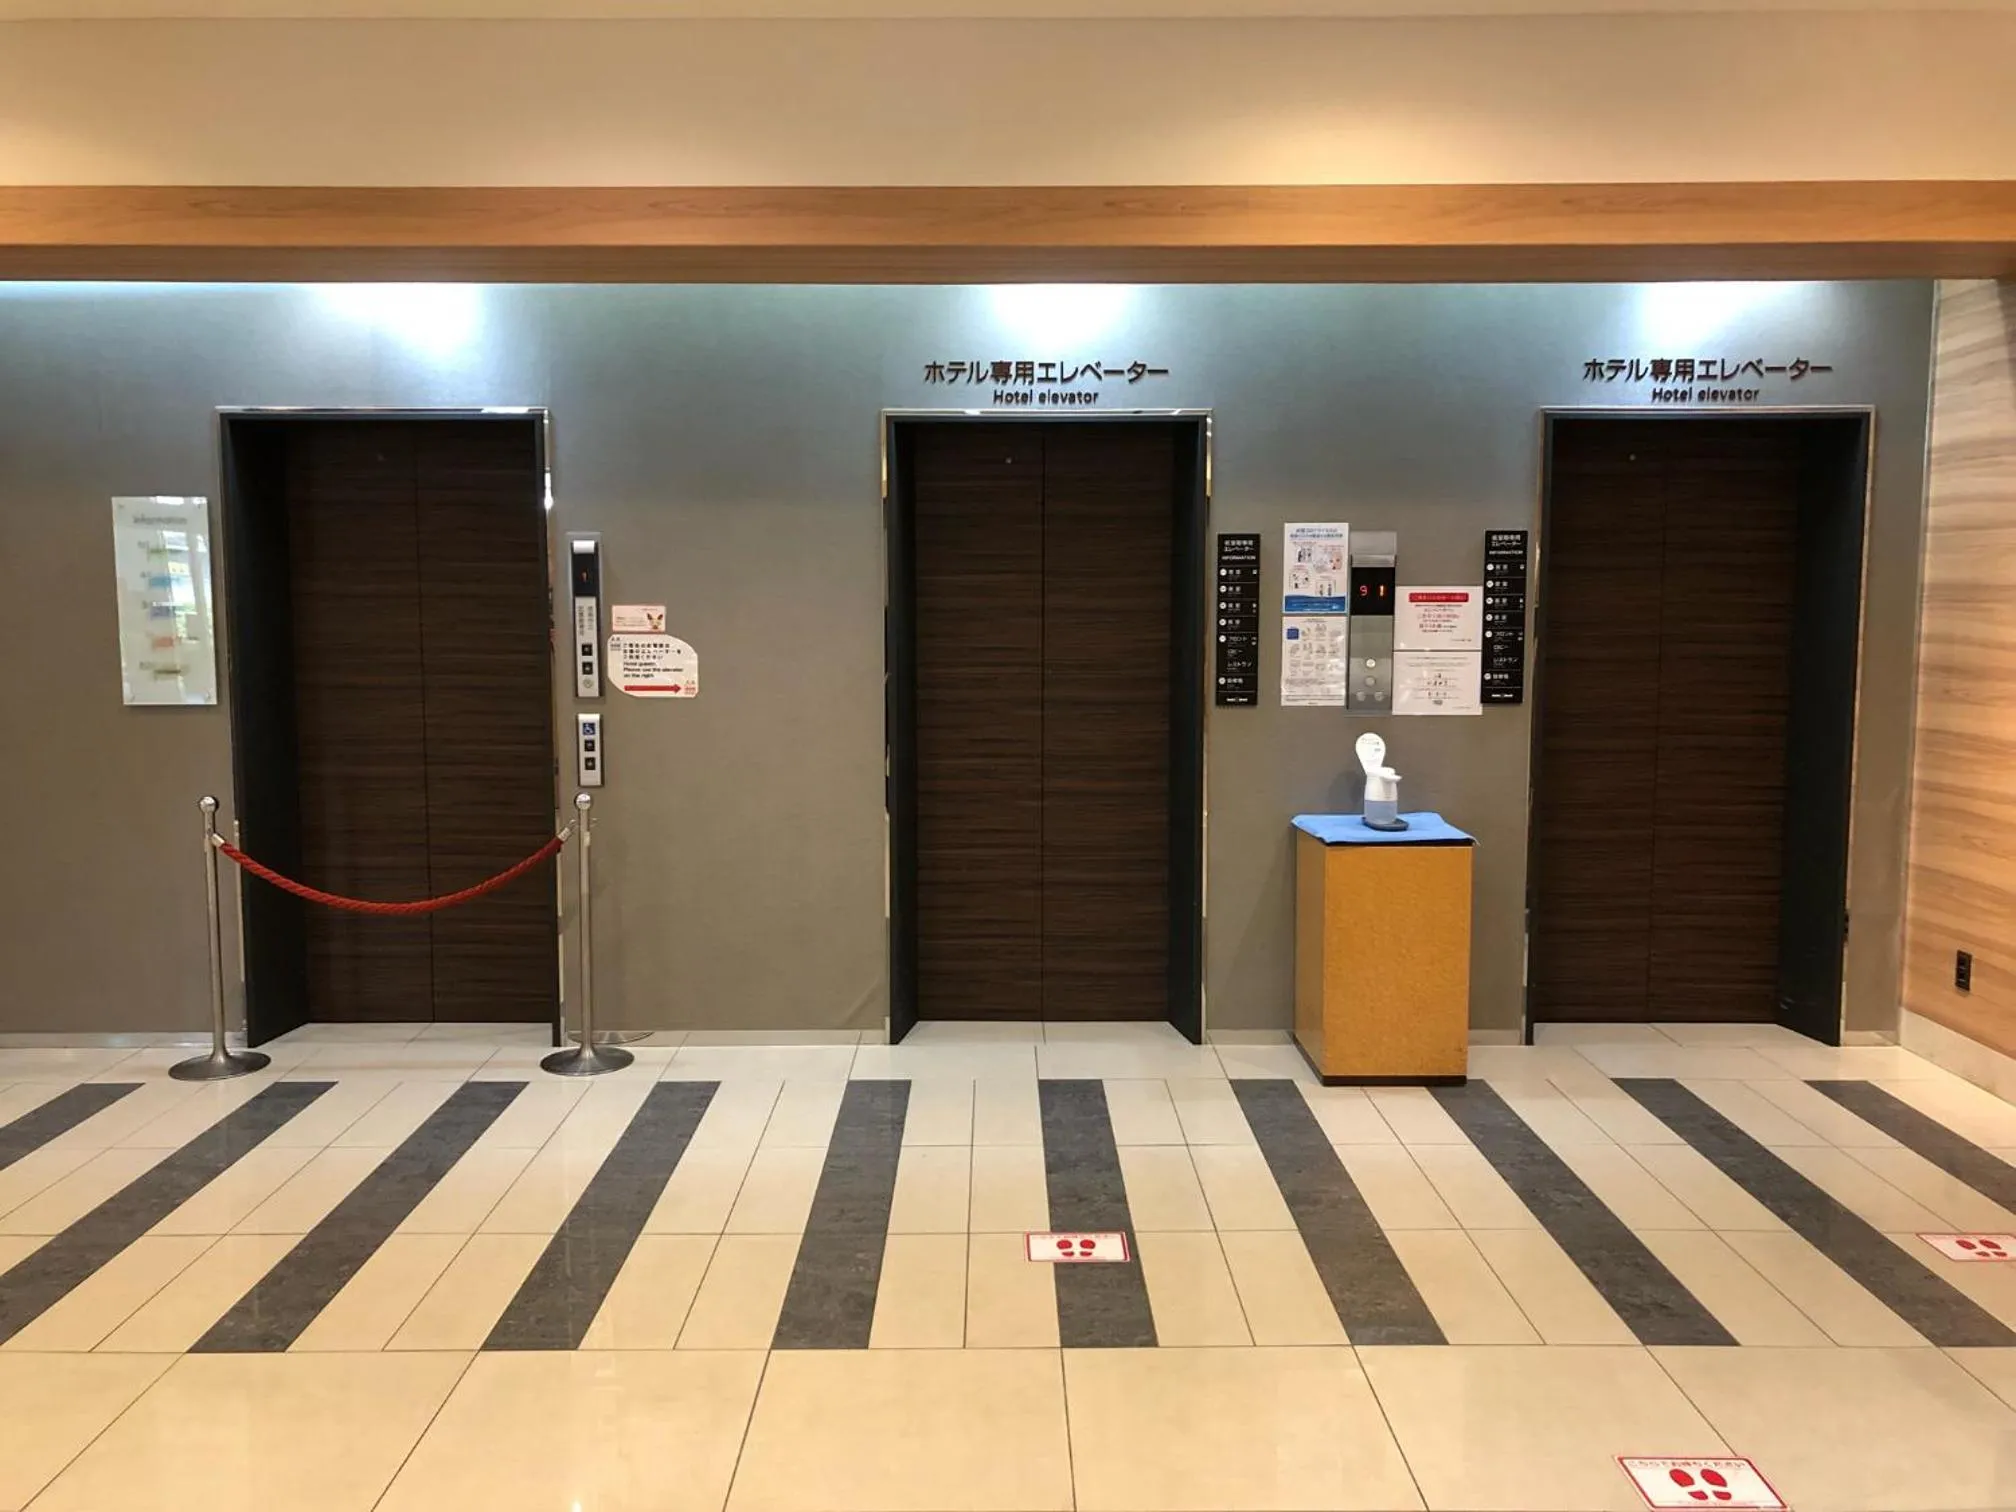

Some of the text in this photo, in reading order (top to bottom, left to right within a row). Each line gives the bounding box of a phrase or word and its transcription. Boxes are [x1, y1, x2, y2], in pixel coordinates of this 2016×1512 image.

[925, 361, 1169, 384] ホテル専用エレベーター
[1584, 358, 1832, 383] ホテル専用エレベーター
[993, 389, 1099, 404] Hotel elevator
[1652, 387, 1759, 402] Hotel elevator
[1359, 585, 1385, 597] 9 1
